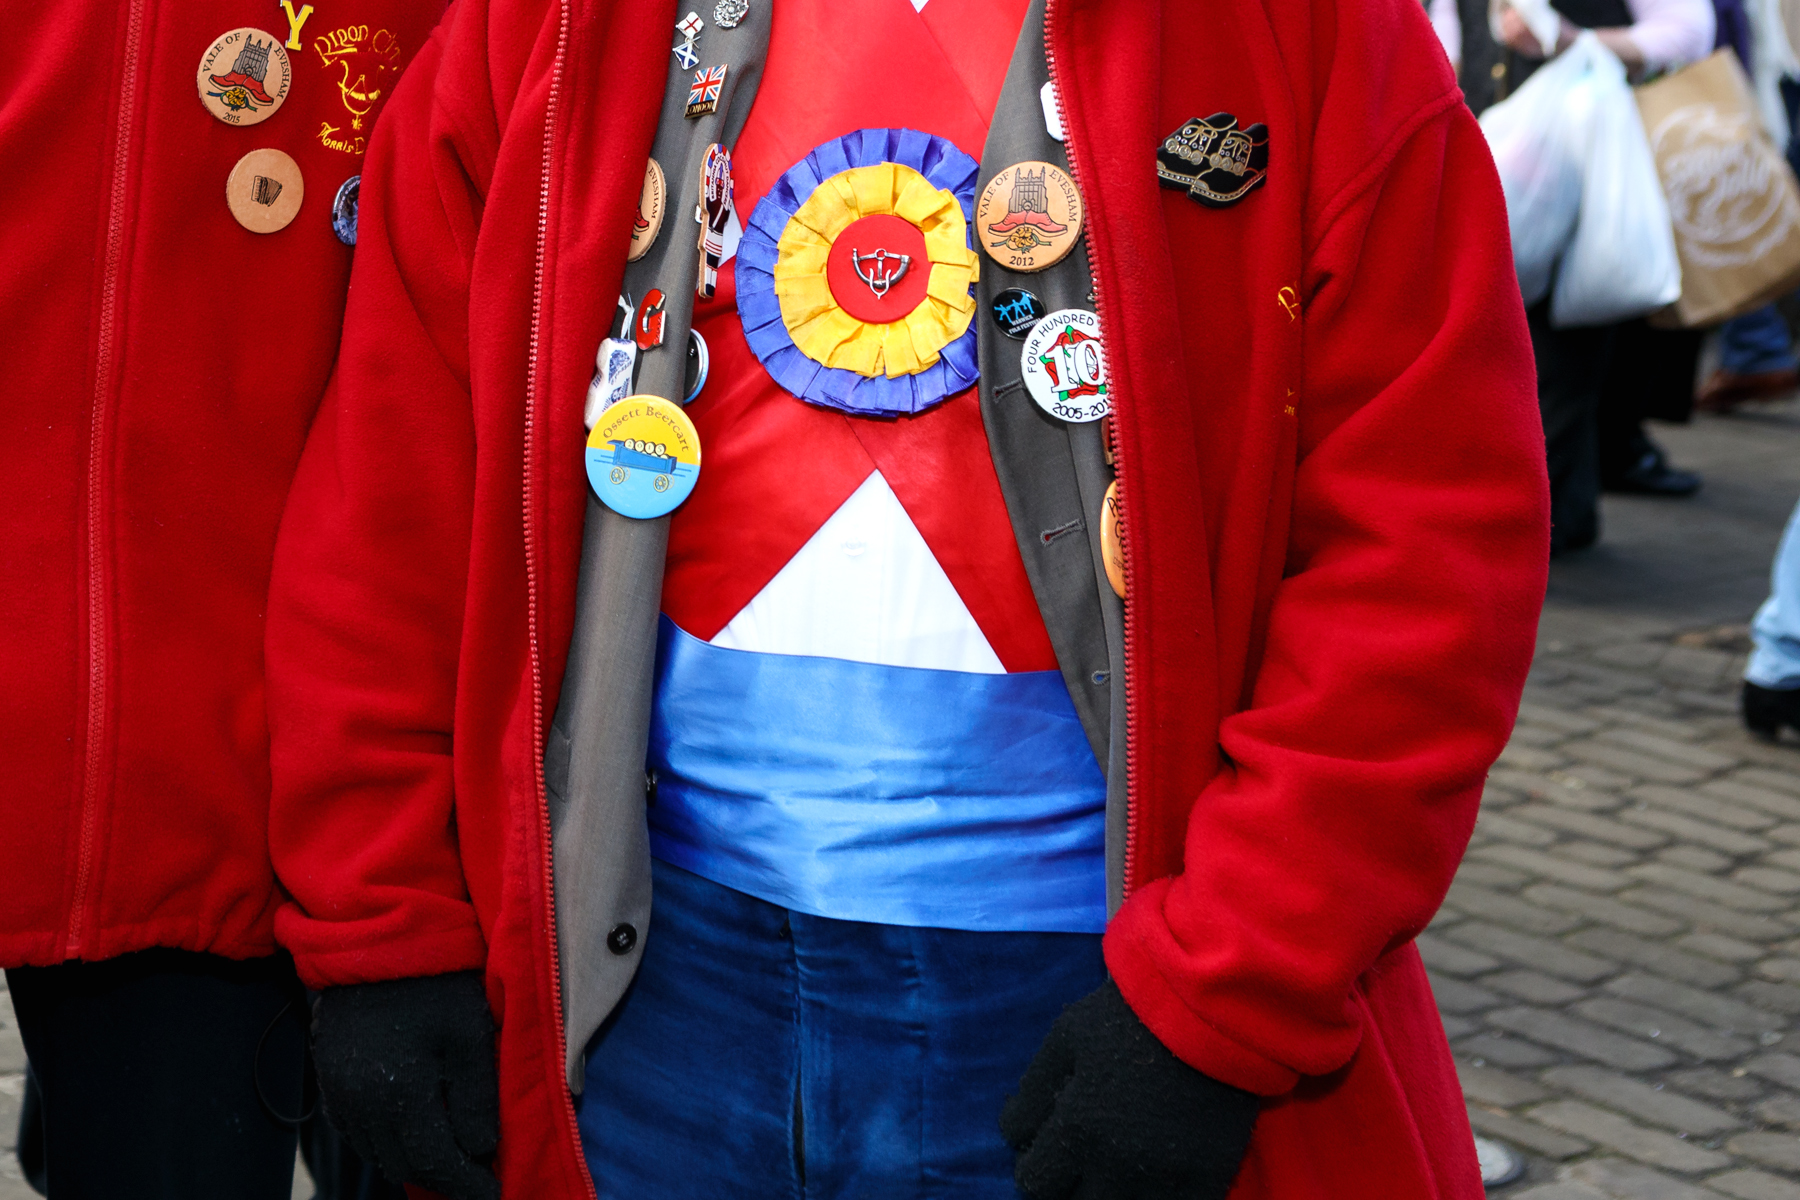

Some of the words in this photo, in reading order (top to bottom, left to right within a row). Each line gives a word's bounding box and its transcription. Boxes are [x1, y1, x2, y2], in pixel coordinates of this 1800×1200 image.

[202, 43, 224, 73] VALE
[225, 32, 241, 45] OF
[273, 46, 290, 100] EVESHAM
[223, 112, 241, 124] 2015
[648, 167, 660, 219] EVESHAM
[980, 186, 996, 218] VALE
[995, 171, 1010, 186] OF
[1049, 169, 1077, 222] EVESHAM
[1009, 255, 1035, 267] 2012
[1027, 339, 1041, 374] FOUR
[1038, 313, 1095, 338] HUNDRED
[1045, 339, 1104, 394] 10
[603, 408, 641, 439] Ossett
[646, 405, 690, 453] Beercart
[1052, 398, 1110, 420] 2005-201
